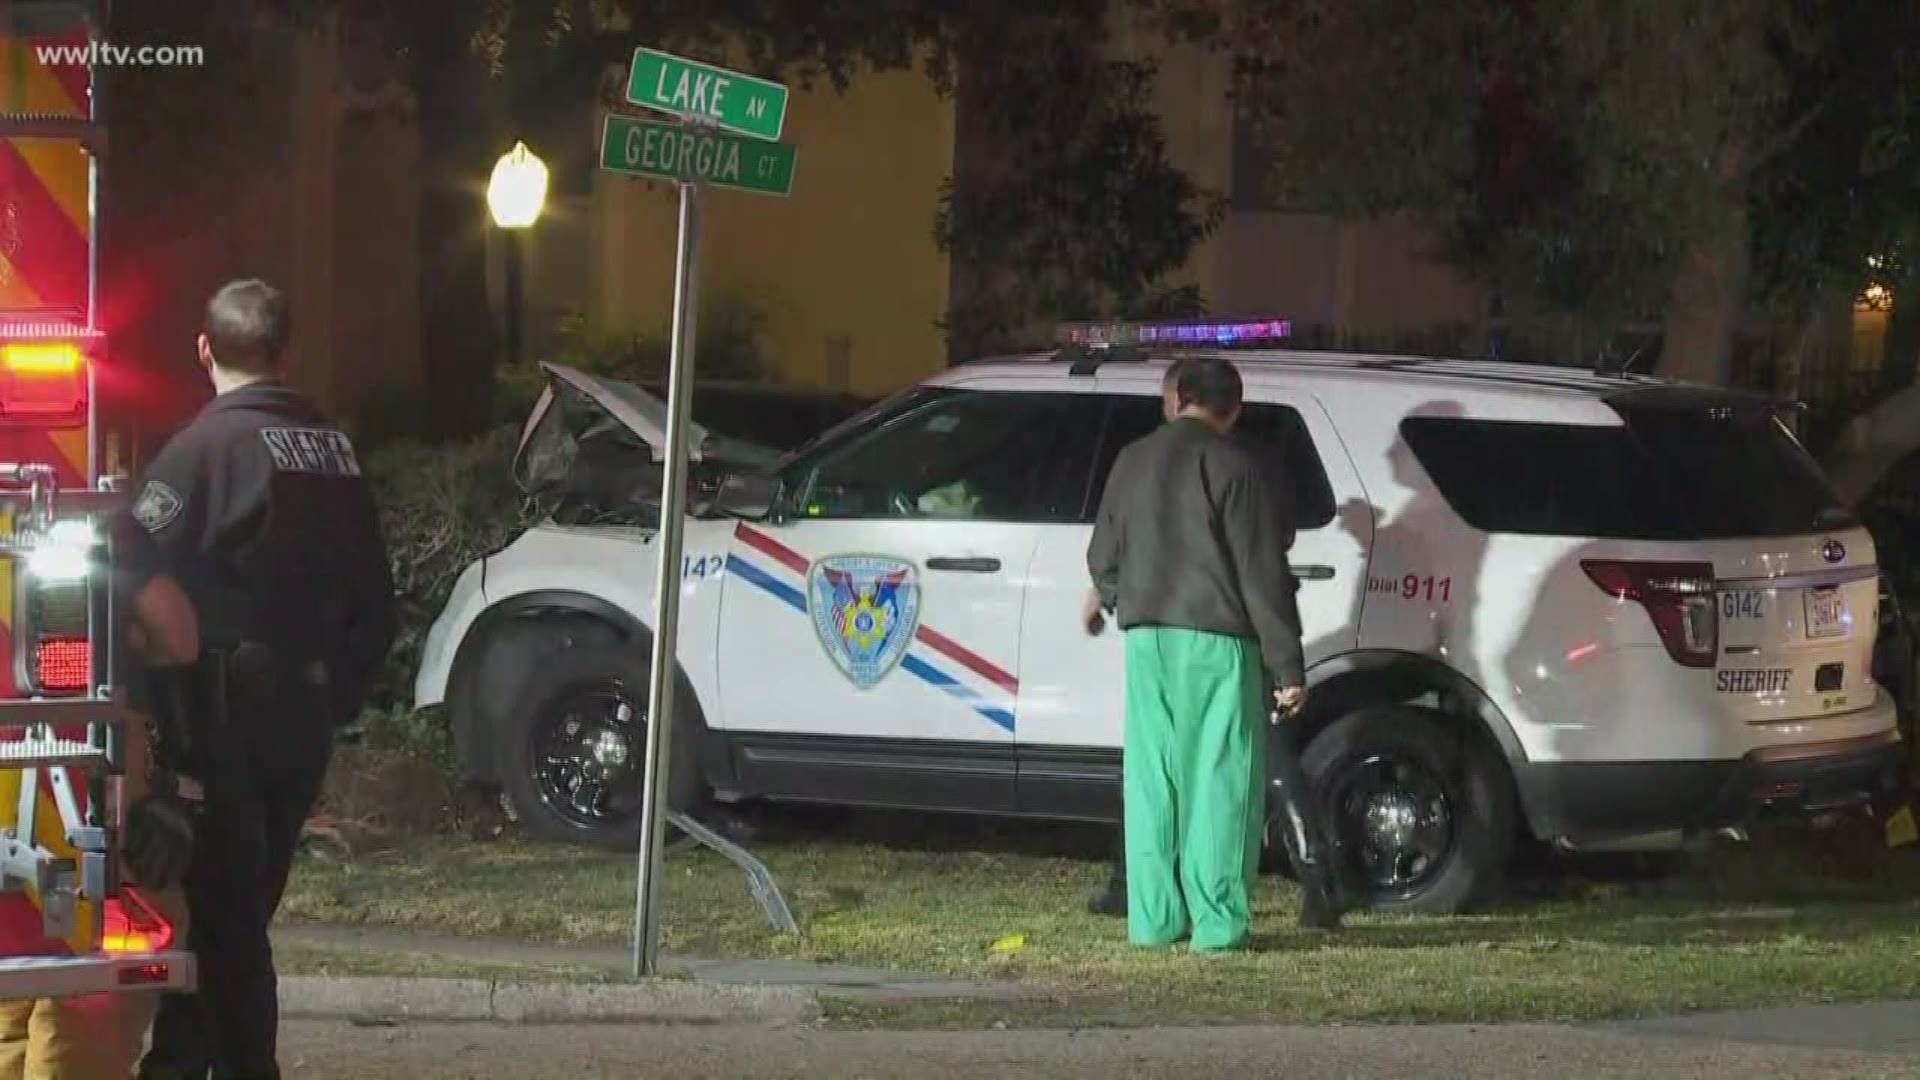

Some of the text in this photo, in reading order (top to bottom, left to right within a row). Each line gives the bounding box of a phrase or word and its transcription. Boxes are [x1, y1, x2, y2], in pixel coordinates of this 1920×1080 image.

[655, 61, 768, 119] LAKE AV
[624, 125, 777, 182] GEORGIA CT
[1402, 574, 1452, 601] 911
[1723, 592, 1764, 618] G142
[1716, 668, 1793, 692] SHERIFF
